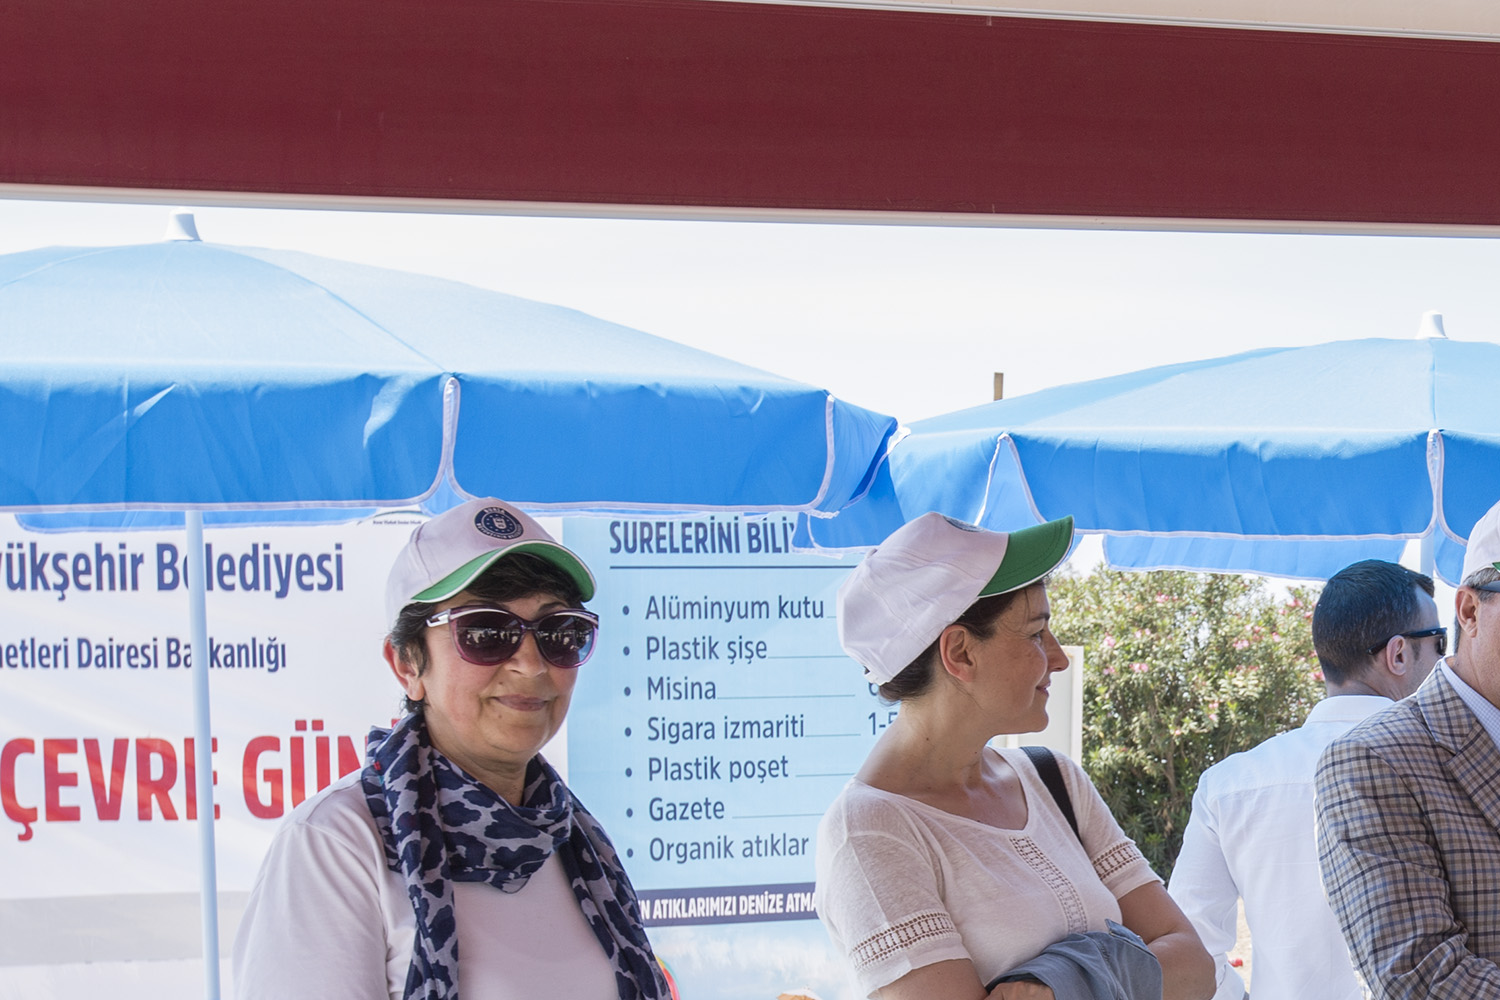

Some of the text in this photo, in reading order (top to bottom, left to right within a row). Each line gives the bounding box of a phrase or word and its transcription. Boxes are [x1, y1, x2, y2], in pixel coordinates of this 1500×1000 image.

[747, 516, 795, 553] BİLİ
[0, 541, 344, 601] ükşehir Blediyesi
[645, 595, 824, 623] Alüminyum kutu
[0, 637, 286, 673] etleri Dairesi Bakanlığı
[647, 635, 767, 664] Plastik şişe
[647, 676, 716, 700] Misina
[648, 717, 715, 744] Sigara
[724, 714, 804, 739] izmariti
[649, 755, 788, 783] Plastik poşet
[649, 797, 725, 821] Gazete
[649, 833, 809, 864] Organik atıklar
[652, 898, 737, 919] ATIKLARIMIZI
[738, 891, 783, 915] DENİZE
